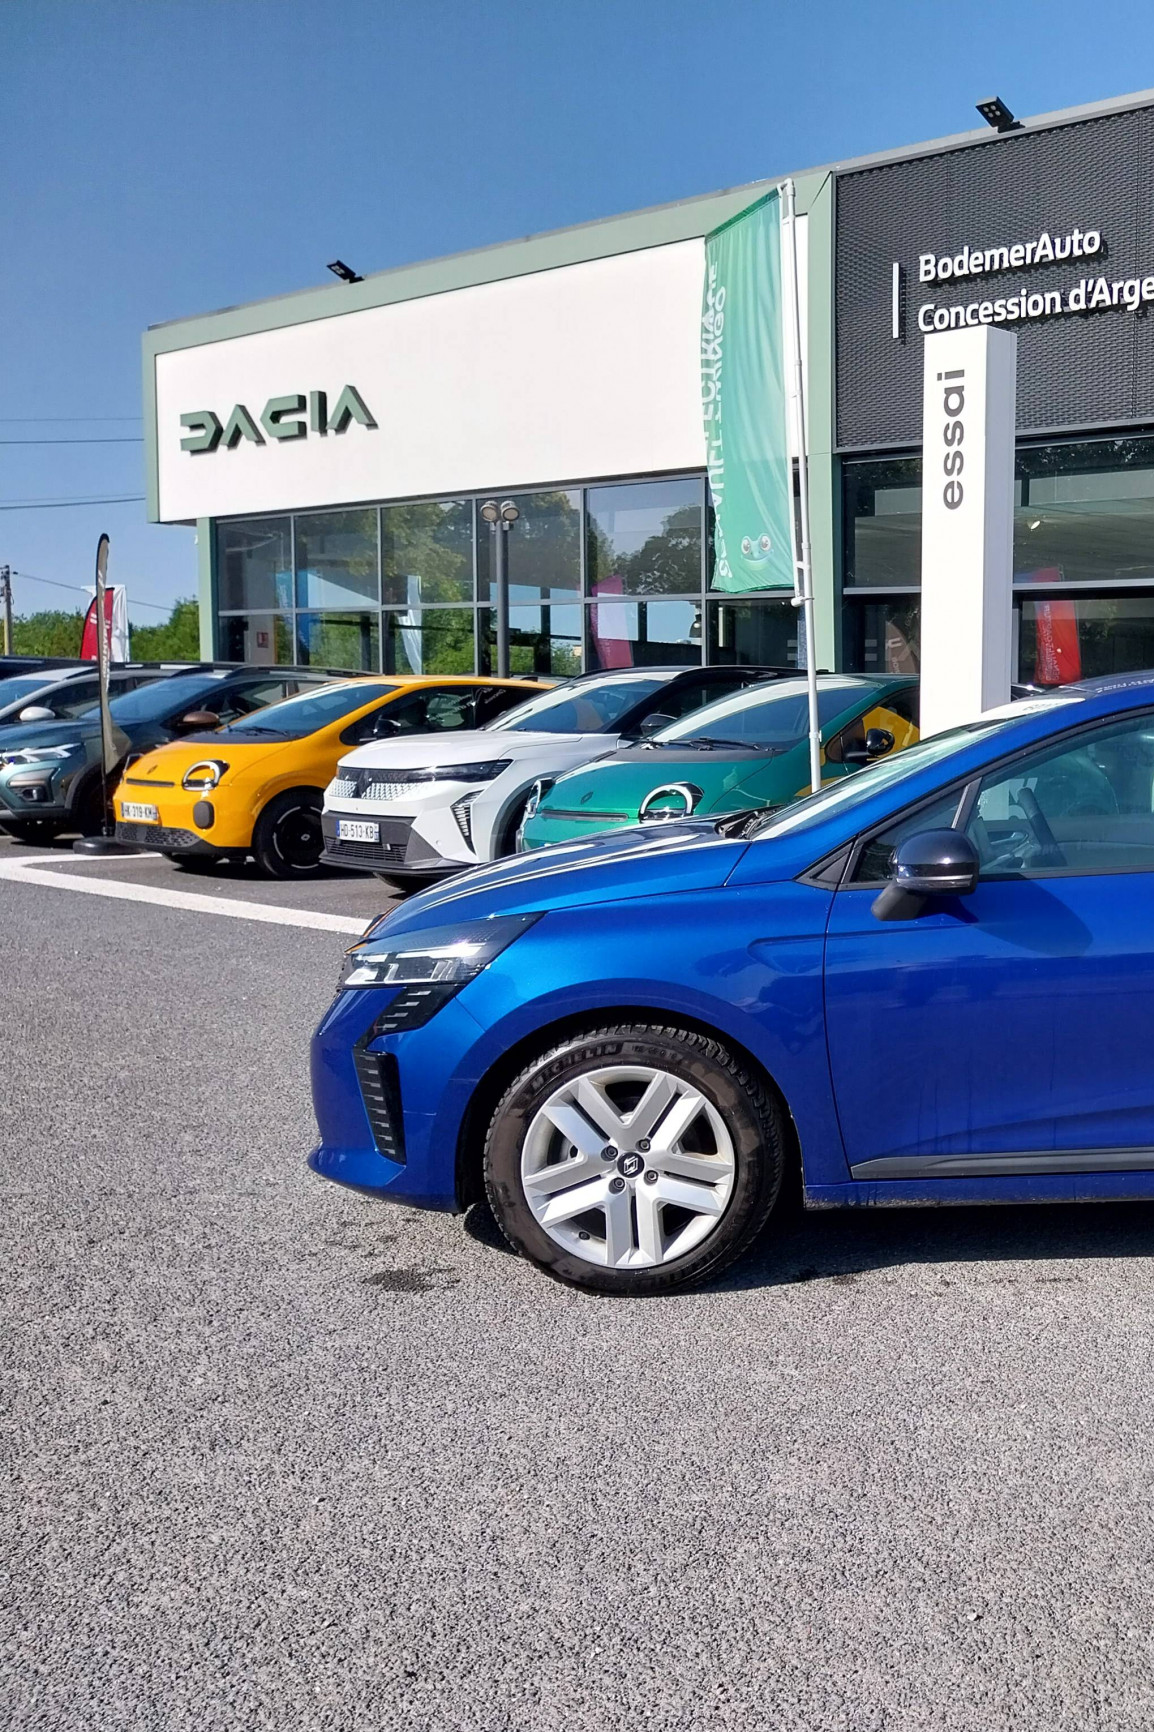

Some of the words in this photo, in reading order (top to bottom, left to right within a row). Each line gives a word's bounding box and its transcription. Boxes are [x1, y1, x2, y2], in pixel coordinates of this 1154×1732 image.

[918, 229, 1102, 283] BodemerAuto
[917, 287, 1063, 333] Concession
[179, 384, 378, 452] DACIA
[936, 368, 966, 511] essai
